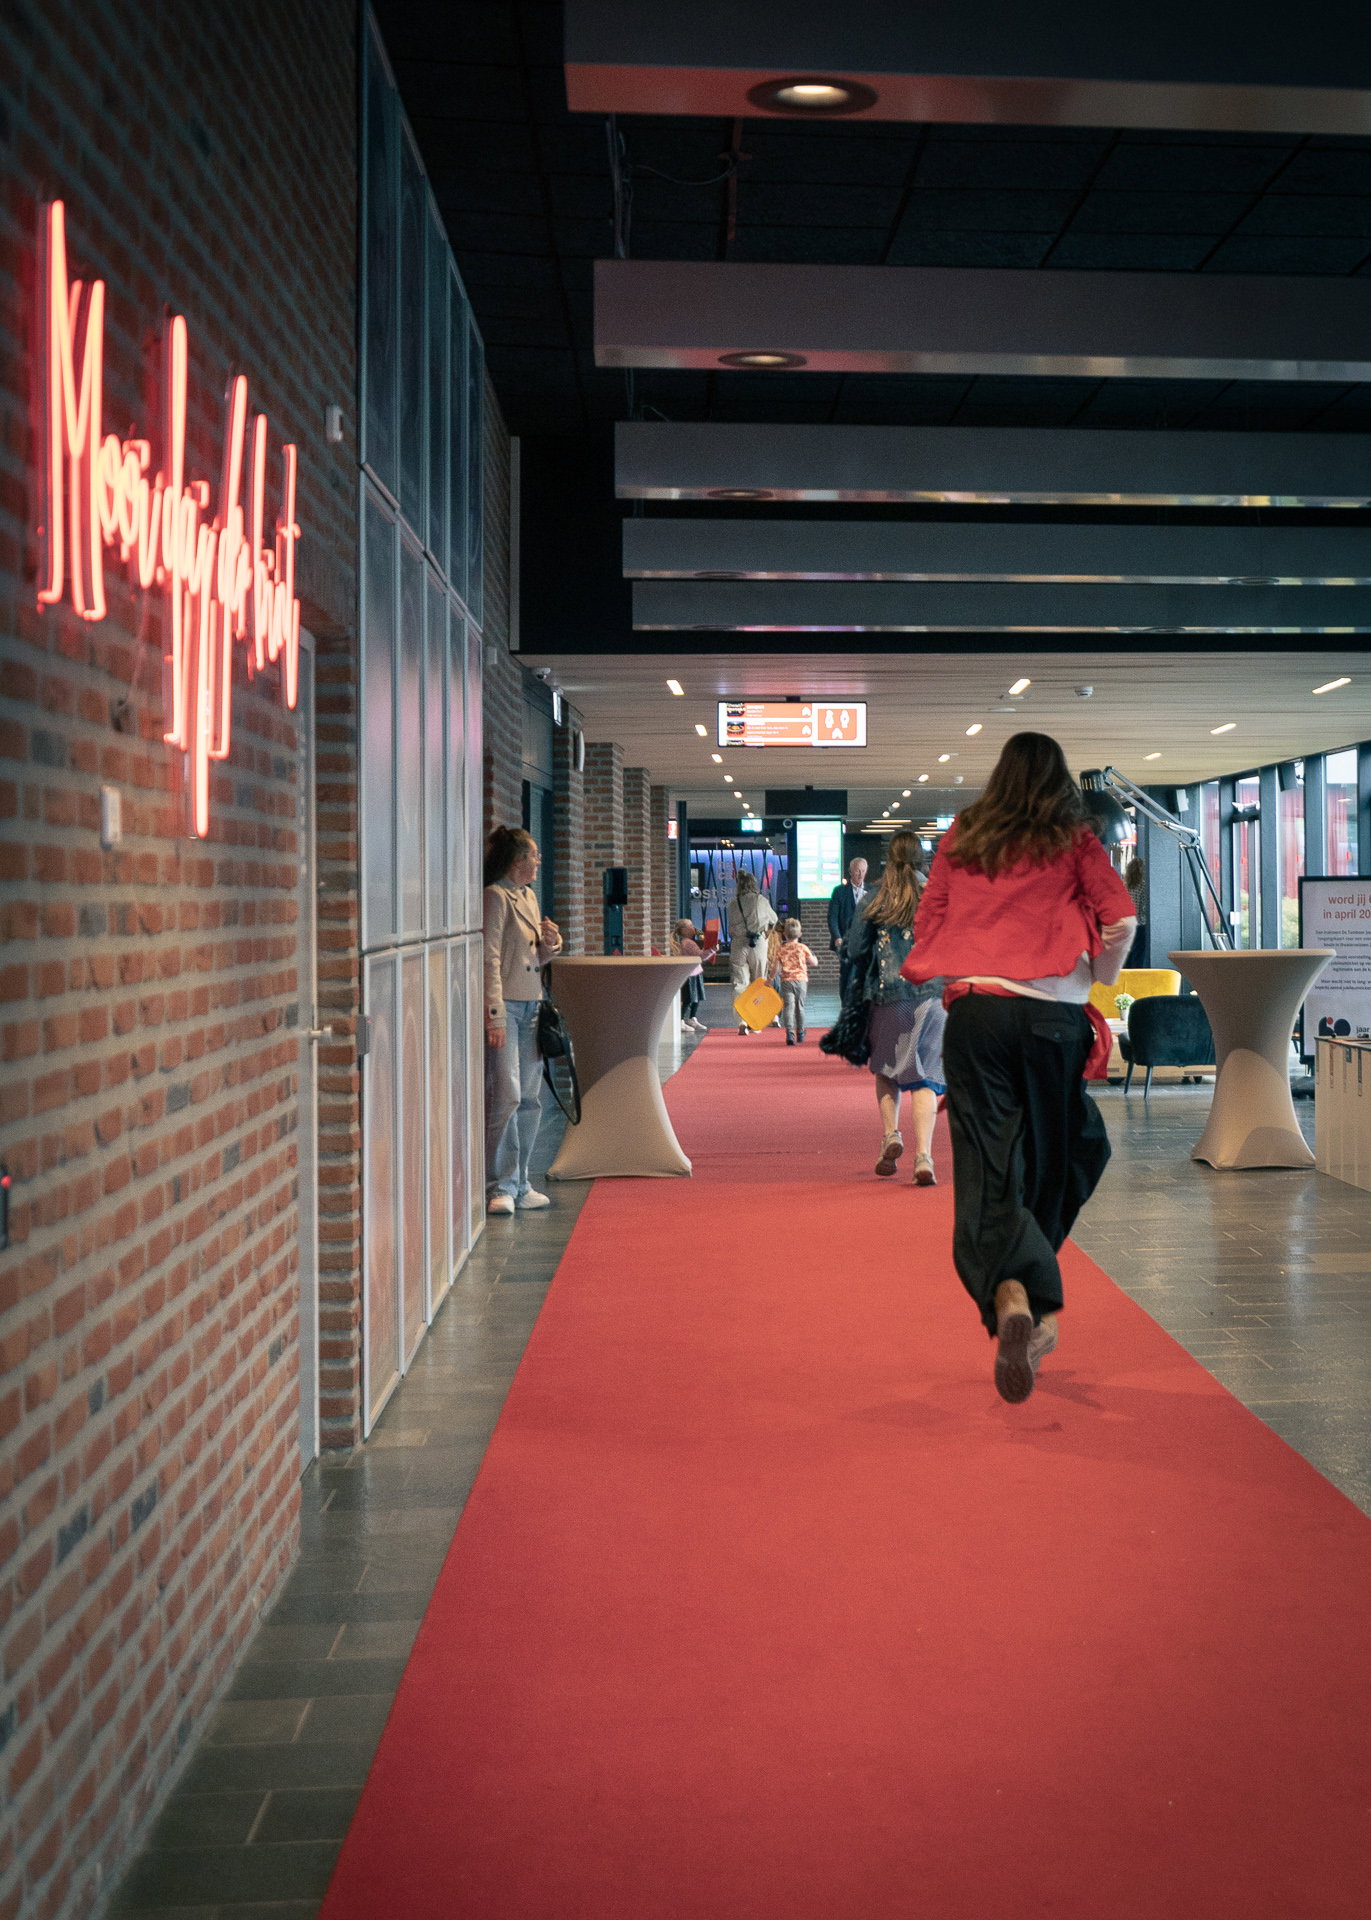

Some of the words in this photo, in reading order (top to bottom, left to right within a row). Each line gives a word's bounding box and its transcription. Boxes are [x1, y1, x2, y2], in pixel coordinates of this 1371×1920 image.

[1328, 894, 1354, 905] word
[1357, 893, 1366, 907] jij
[1323, 909, 1332, 919] in
[1334, 908, 1356, 921] april
[1356, 1026, 1370, 1034] jaar
